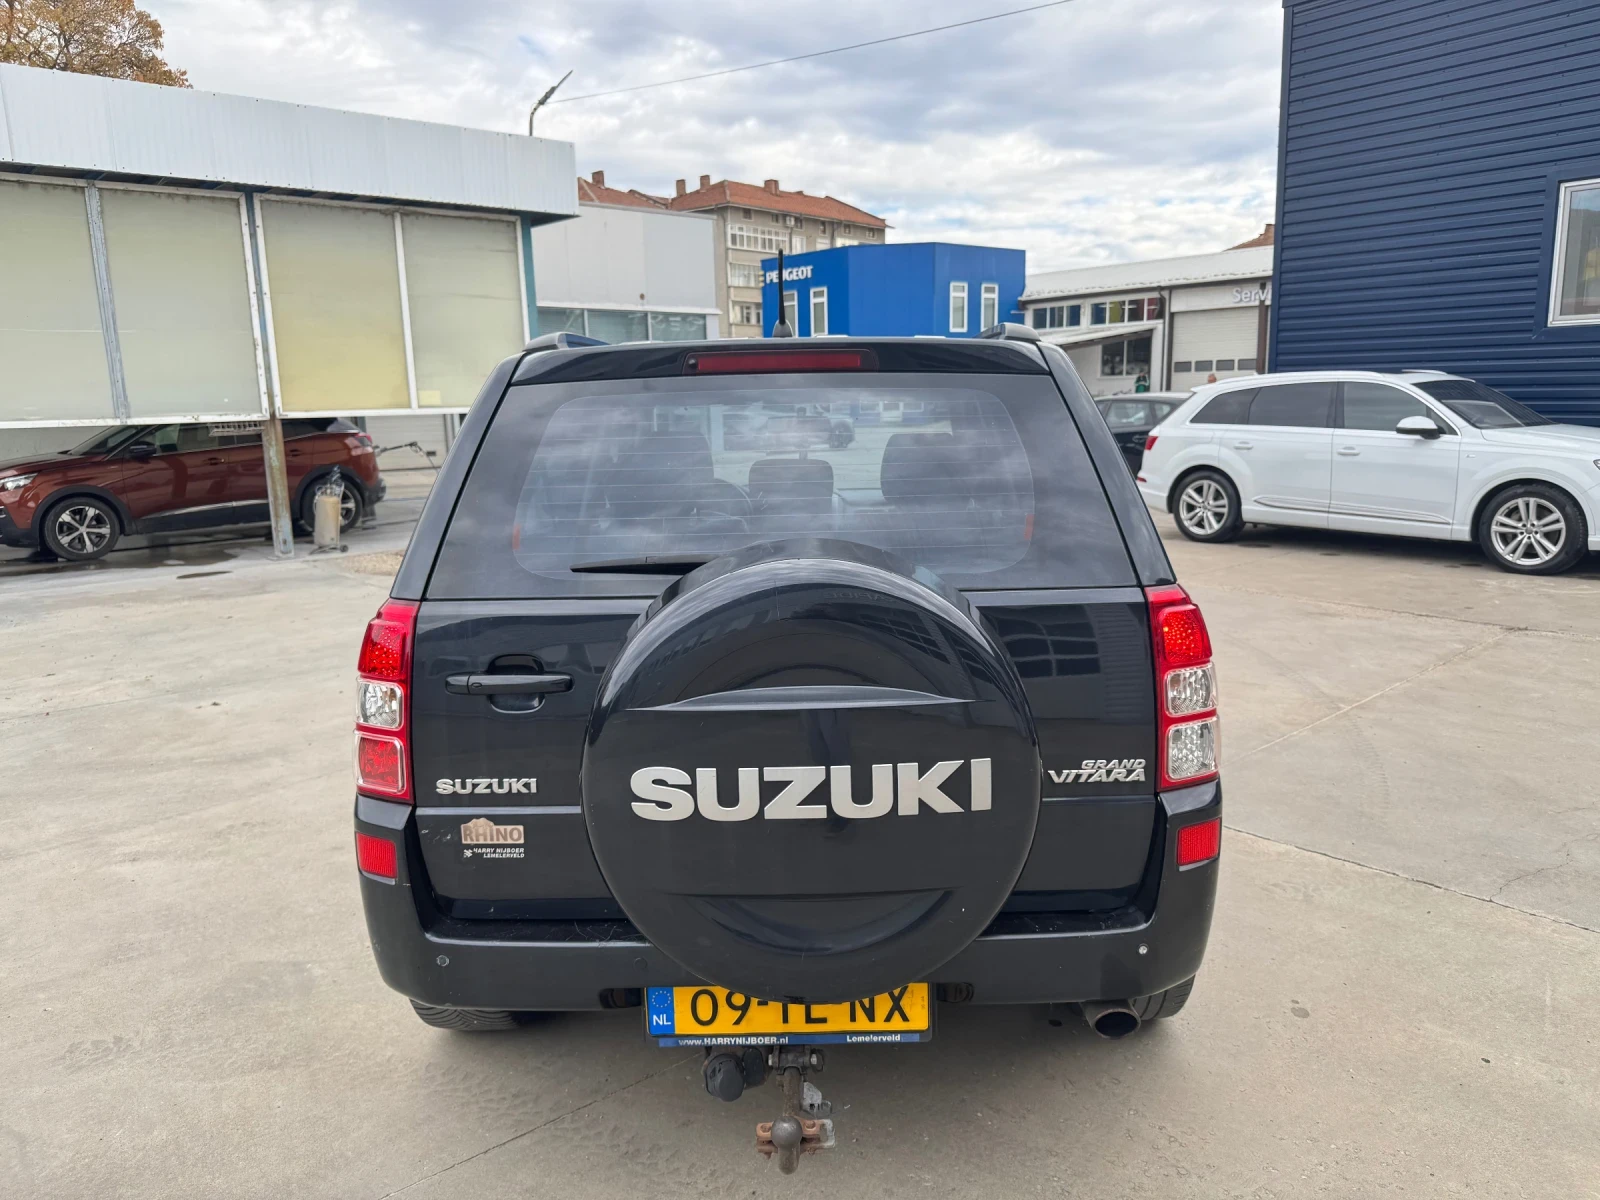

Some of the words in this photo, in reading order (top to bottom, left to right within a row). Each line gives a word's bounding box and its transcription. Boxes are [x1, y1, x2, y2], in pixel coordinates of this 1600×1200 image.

[1081, 759, 1146, 770] GRAND
[1047, 768, 1146, 783] VITARA
[436, 778, 537, 794] SUZUKI
[630, 758, 992, 821] SUZUKI
[463, 825, 523, 842] RHINO
[652, 1013, 671, 1026] NL
[678, 1036, 788, 1046] www.HARRYNIJBOER.nl
